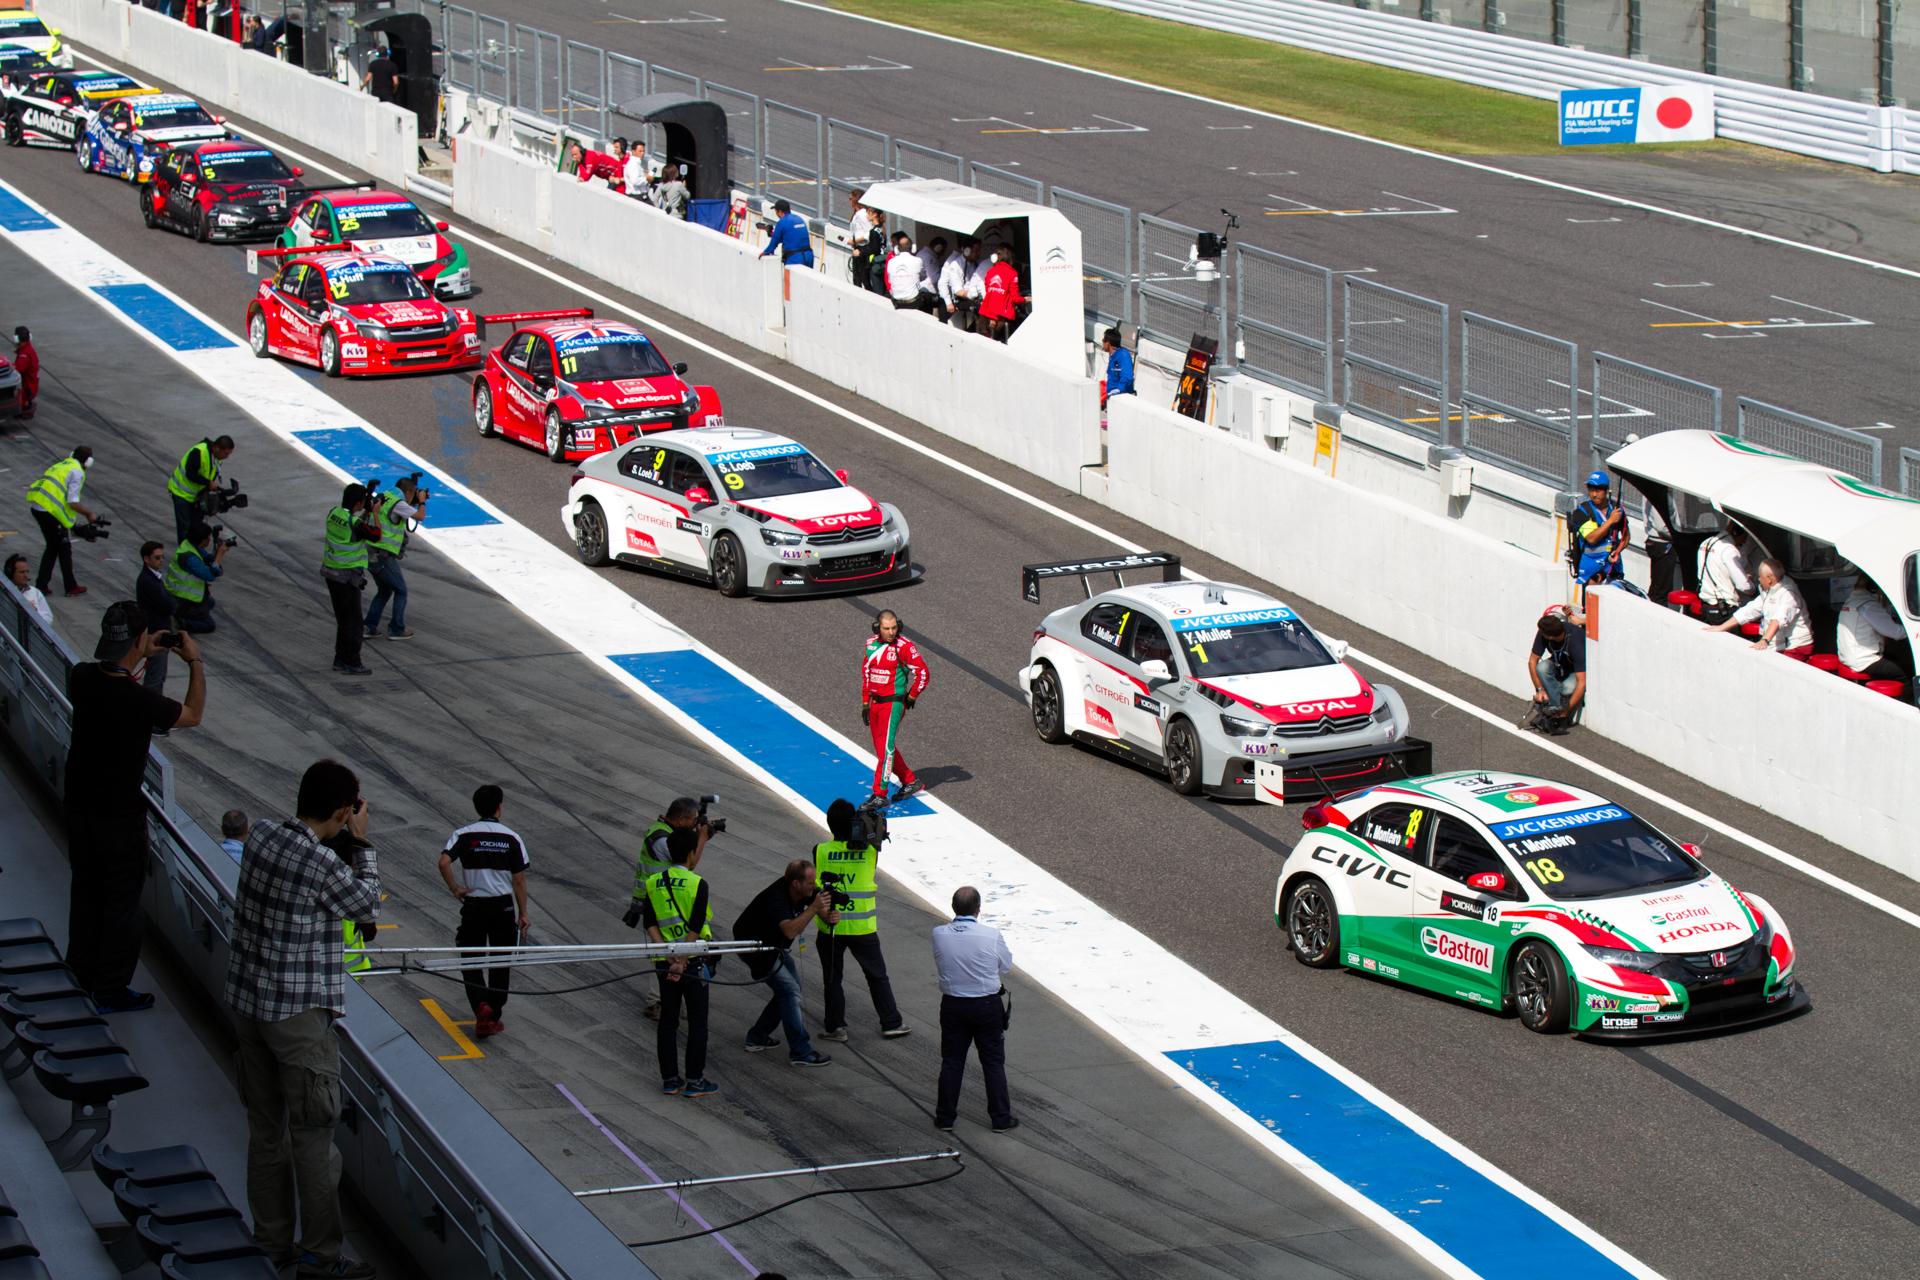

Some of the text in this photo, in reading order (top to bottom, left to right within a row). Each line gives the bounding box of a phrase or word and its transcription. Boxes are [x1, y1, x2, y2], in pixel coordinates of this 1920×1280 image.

[1565, 99, 1635, 118] WTCC
[22, 108, 76, 139] CAMOZZI
[1565, 126, 1612, 134] Championship
[1577, 119, 1596, 127] World
[1597, 119, 1621, 127] Touring
[204, 168, 216, 179] 5
[340, 218, 360, 232] 25
[329, 273, 365, 286] R.Huff
[330, 283, 350, 300] 12
[346, 347, 365, 355] KW
[559, 345, 599, 358] J.Thompson
[561, 356, 578, 375] 11
[653, 450, 665, 470] 9
[719, 460, 756, 473] S. Loeb
[631, 464, 653, 480] S. Loeb
[724, 473, 745, 490] 9
[637, 512, 673, 529] CITROËN
[811, 513, 871, 527] TOTAL
[704, 525, 710, 536] 9
[629, 535, 655, 550] TOTAL
[783, 549, 802, 558] KW
[1118, 611, 1131, 635] 1
[1190, 644, 1209, 664] 1
[1095, 684, 1130, 706] CITROËN
[1281, 700, 1357, 715] TOTAL
[1088, 707, 1114, 728] TOTAL
[1245, 744, 1268, 753] KW
[1405, 808, 1423, 836] 18
[1367, 822, 1402, 846] T. Monteiro
[480, 841, 510, 849] YOKOHAMA
[1508, 834, 1577, 856] T. Monteiro
[828, 851, 866, 860] WTCC
[1311, 845, 1412, 889] CIVIC
[1525, 857, 1565, 885] 18
[656, 877, 688, 888] WCC
[1451, 899, 1498, 921] YOKOHAMA 18
[1665, 905, 1711, 922] Castrol
[1657, 921, 1742, 944] HONDA
[1439, 934, 1489, 968] Castrol
[1379, 962, 1399, 975] brose
[1591, 999, 1618, 1009] KW
[1633, 1003, 1658, 1012] Castrol
[1602, 1015, 1638, 1026] brose
